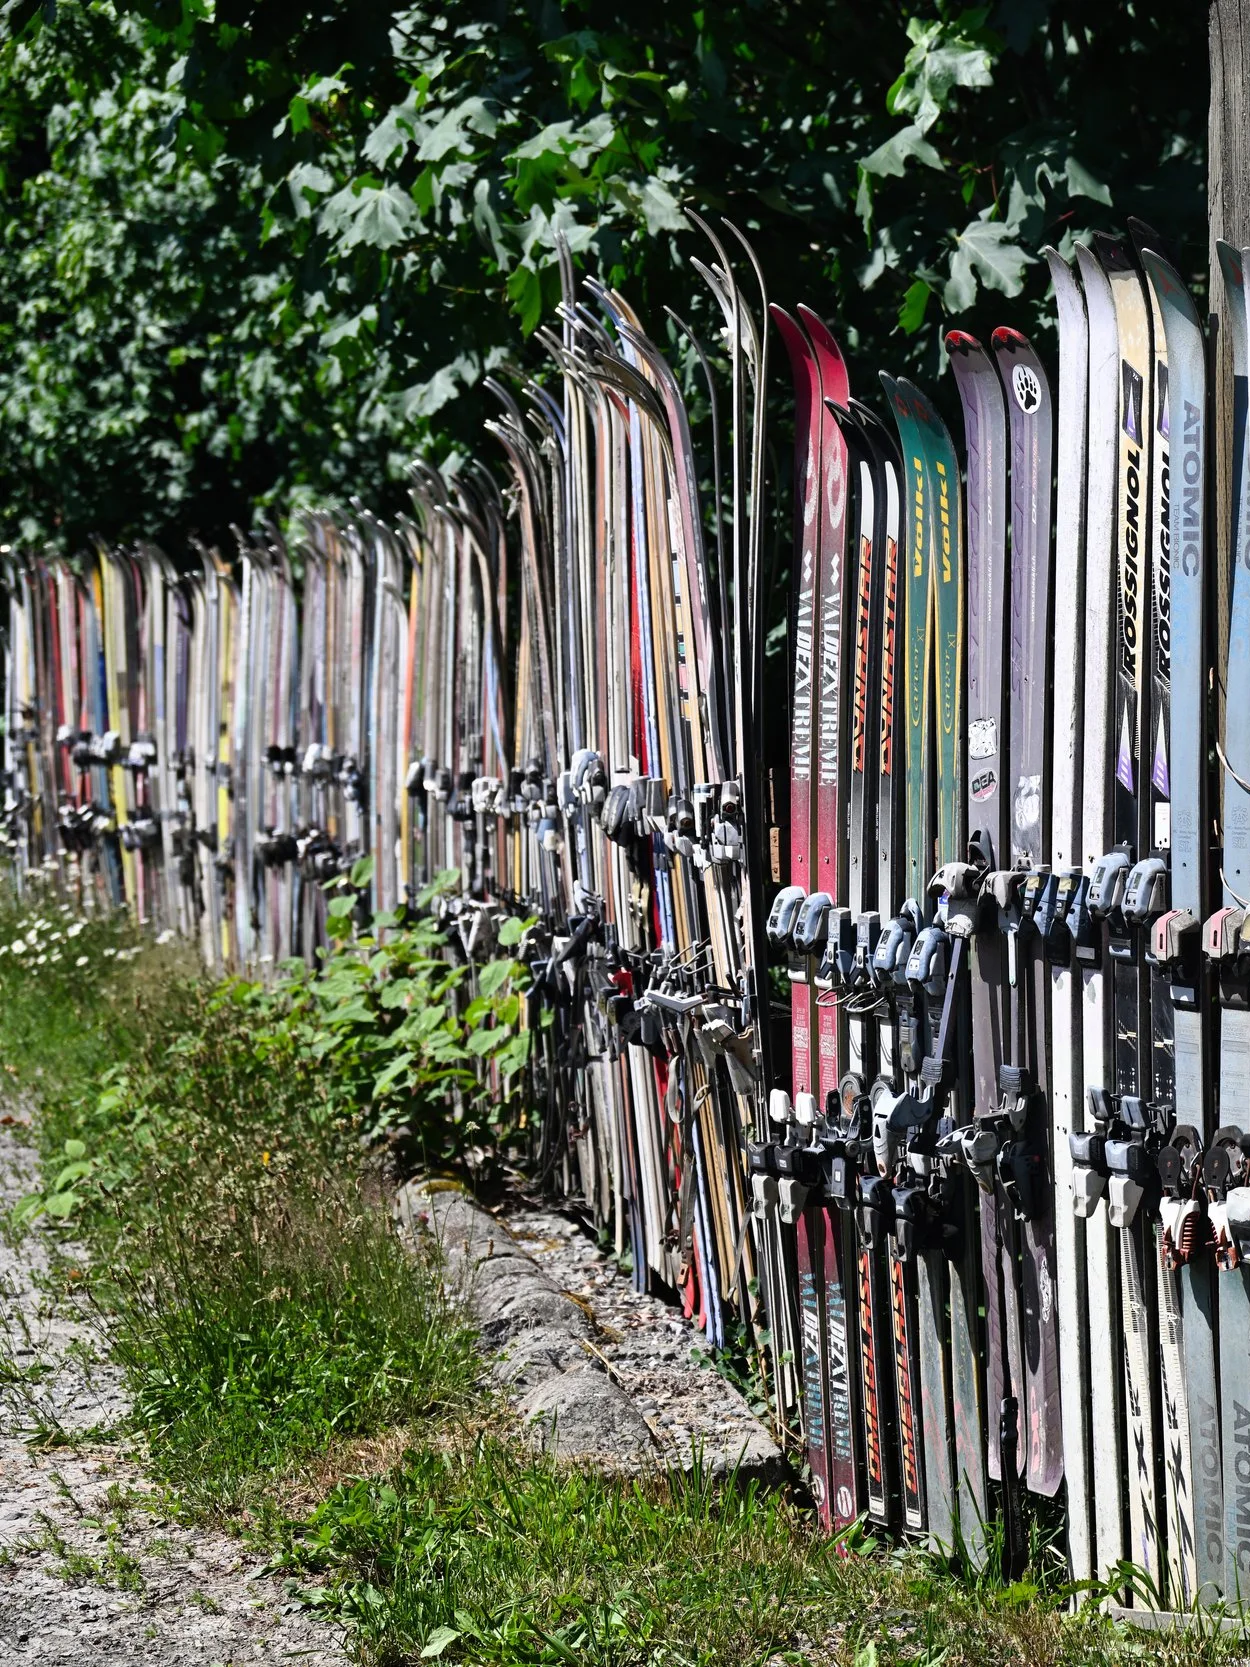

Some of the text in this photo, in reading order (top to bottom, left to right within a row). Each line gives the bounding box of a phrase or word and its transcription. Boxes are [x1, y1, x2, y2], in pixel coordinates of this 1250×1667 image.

[1121, 449, 1141, 677] ROSSIGNOL
[1183, 400, 1200, 577] ATOMIC
[858, 1253, 881, 1483] OMEGLASS
[1197, 1396, 1223, 1567] ATOMIC
